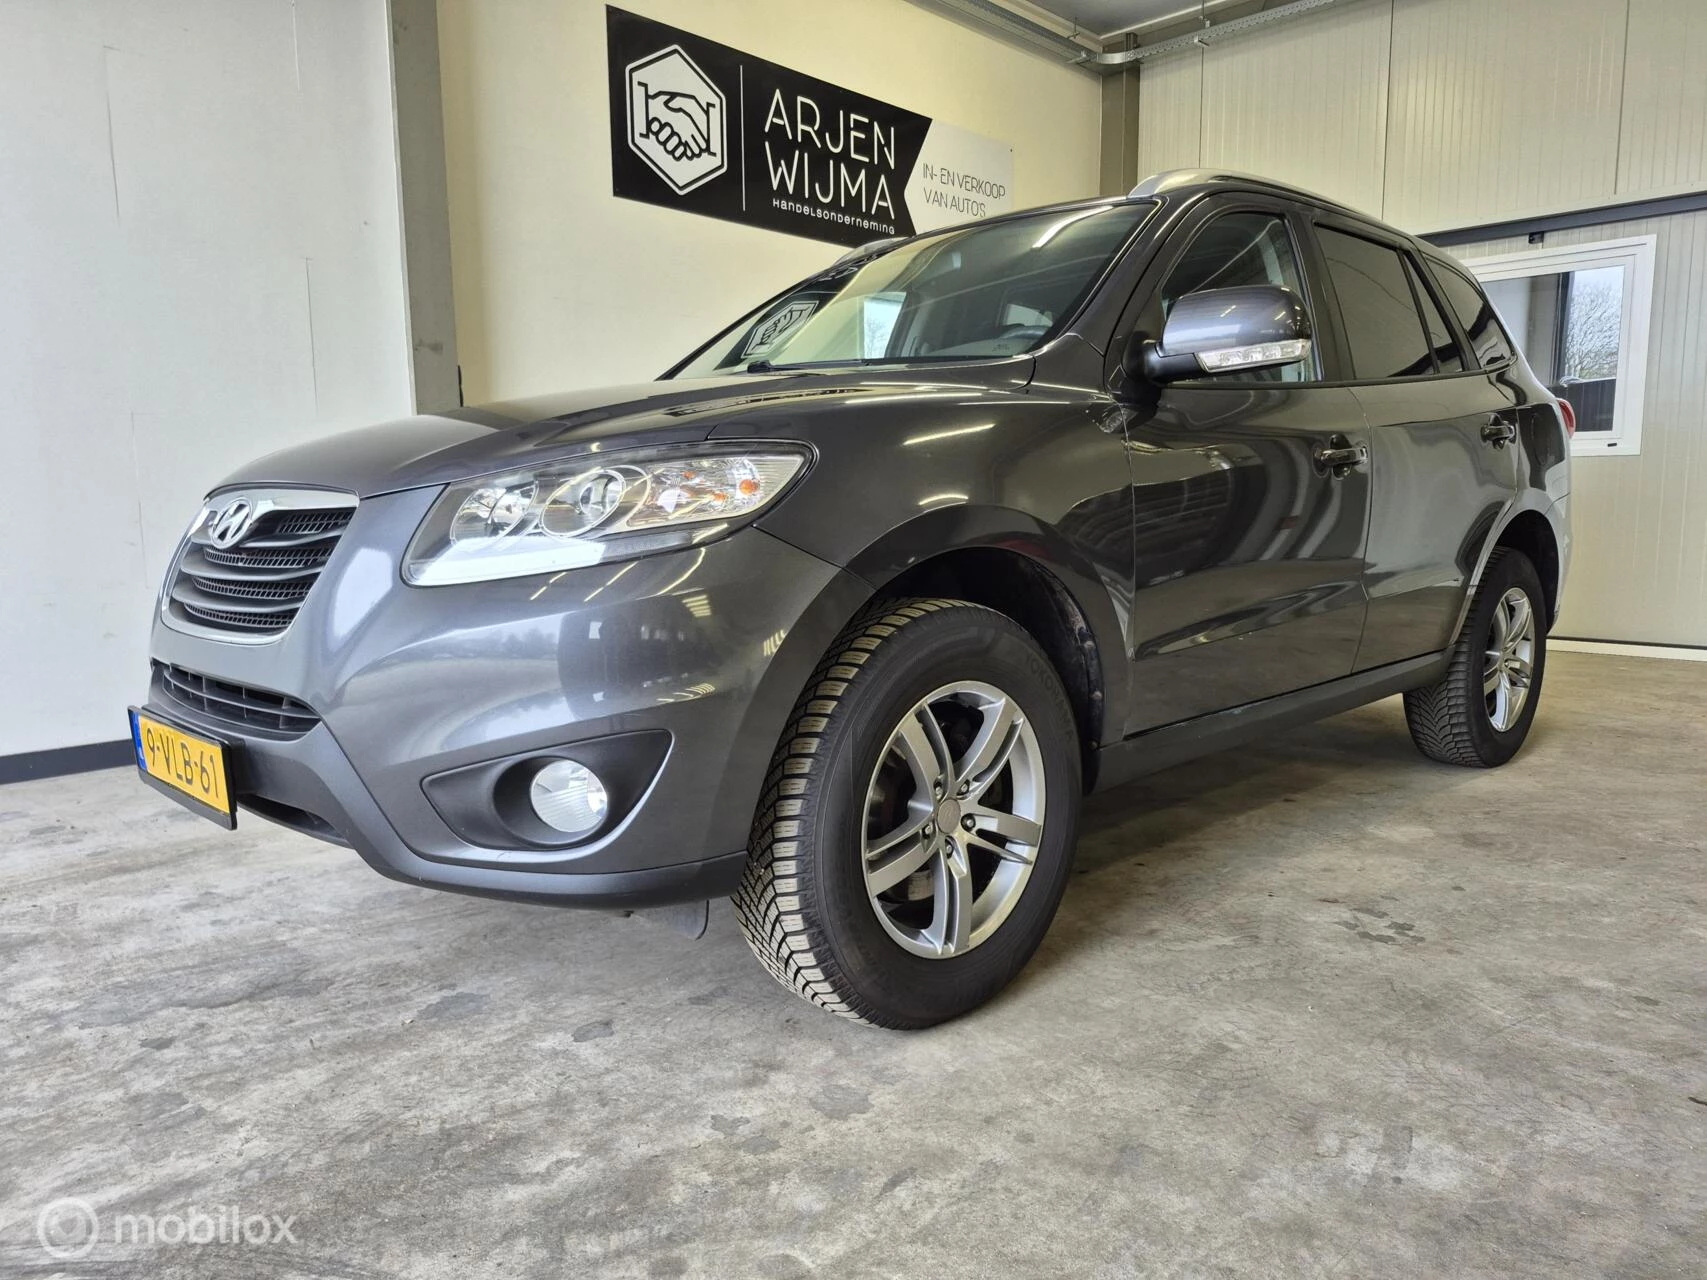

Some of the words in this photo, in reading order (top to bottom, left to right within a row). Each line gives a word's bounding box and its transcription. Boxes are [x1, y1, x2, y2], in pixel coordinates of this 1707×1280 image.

[764, 88, 895, 170] ARJEN
[764, 141, 895, 220] WIJMA
[922, 163, 938, 181] IN-
[940, 167, 955, 188] EN
[957, 174, 1006, 200] VERKOOP
[923, 187, 948, 209] VAN
[146, 727, 219, 799] 9-VLB-61
